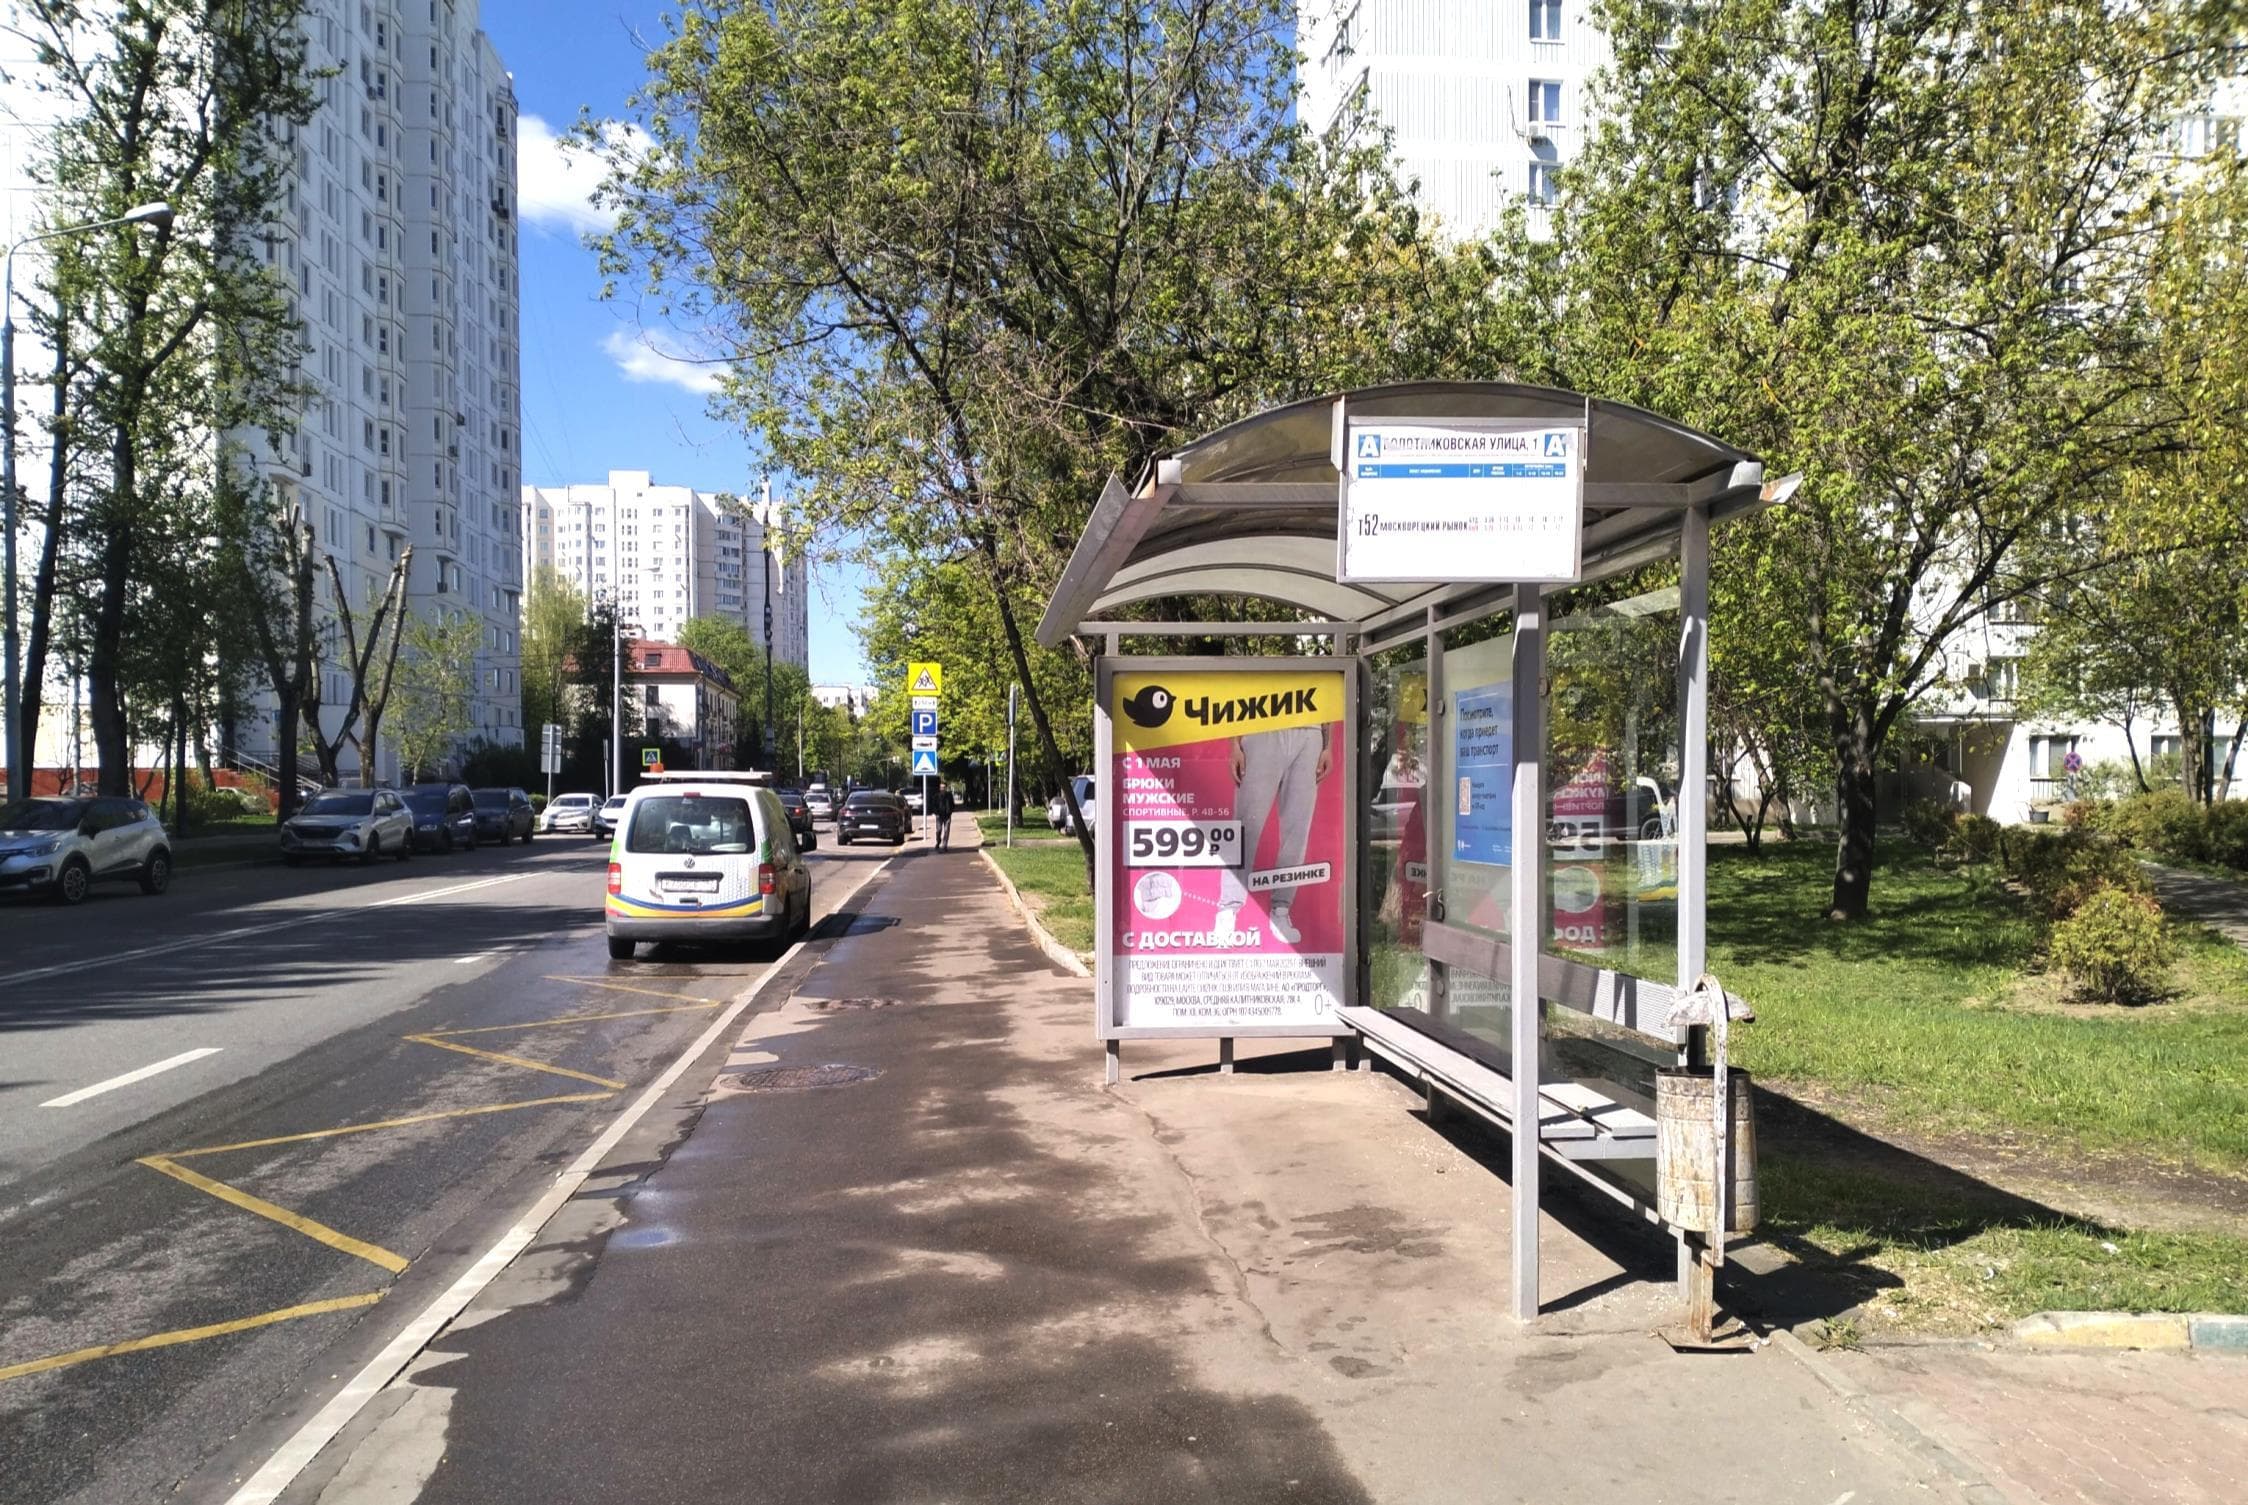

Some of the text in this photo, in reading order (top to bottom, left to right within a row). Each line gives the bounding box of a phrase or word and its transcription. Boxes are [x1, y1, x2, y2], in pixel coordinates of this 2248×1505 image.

[1490, 437, 1529, 451] УЛИЦА,
[1533, 437, 1538, 449] 1
[1442, 520, 1467, 531] РЫНОК
[1122, 757, 1181, 768] С 1 МАЯ
[1123, 778, 1175, 789] БРЮКИ
[1123, 793, 1195, 804] МУЖСКИЕ
[1201, 808, 1230, 817] 48-56
[1132, 827, 1235, 858] 599 00
[1252, 868, 1326, 888] НА РЕЗИНКЕ
[1122, 927, 1261, 950] С ДОСТАВКОЙ
[1314, 994, 1332, 1015] 0+
